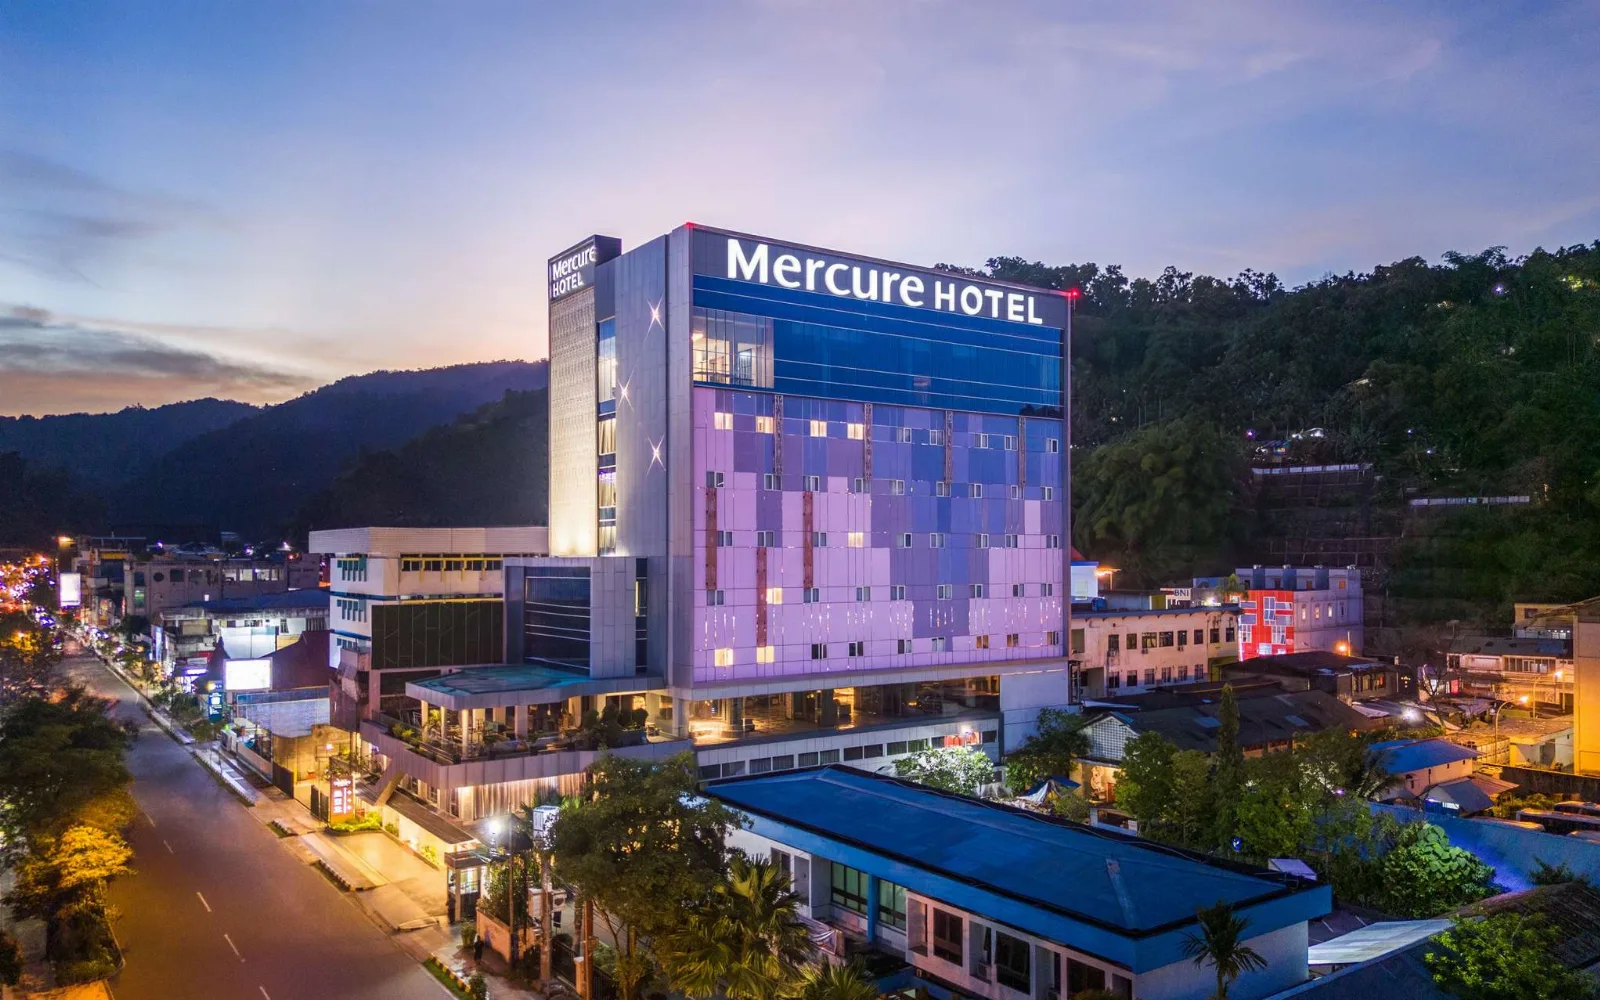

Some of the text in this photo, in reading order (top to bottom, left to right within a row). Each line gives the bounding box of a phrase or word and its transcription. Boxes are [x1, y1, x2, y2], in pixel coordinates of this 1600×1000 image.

[552, 245, 597, 281] Mercure
[552, 271, 584, 298] HOTEL
[727, 238, 1043, 325] Mercure HOTEL
[1174, 589, 1190, 597] BNI
